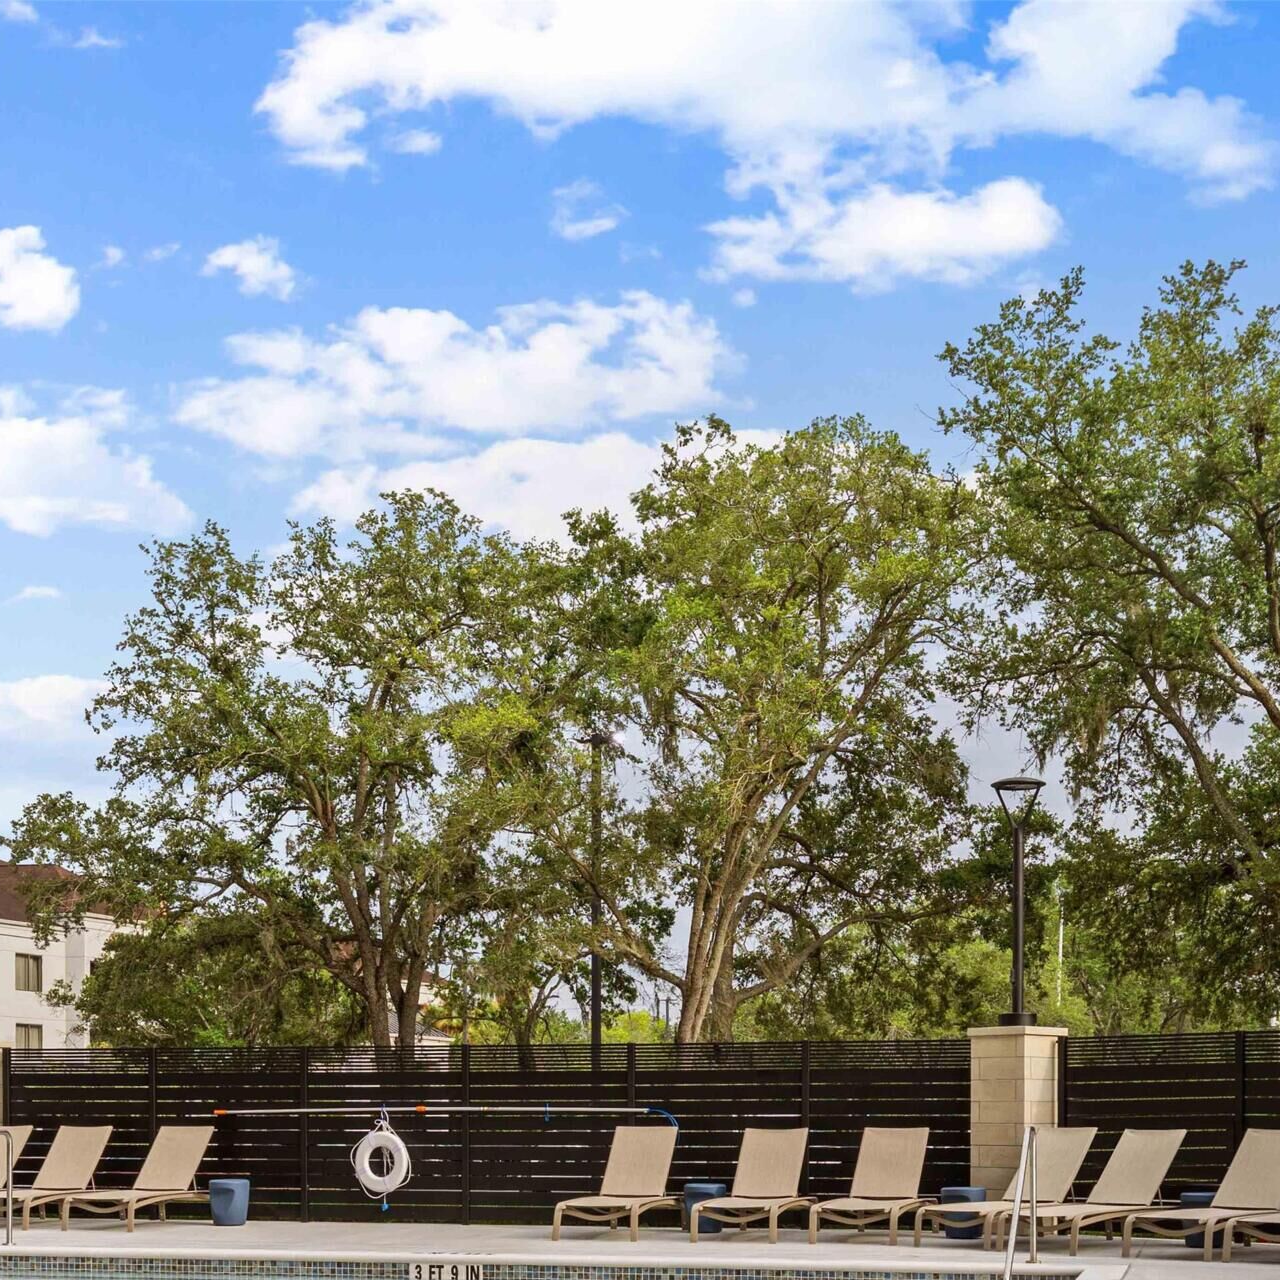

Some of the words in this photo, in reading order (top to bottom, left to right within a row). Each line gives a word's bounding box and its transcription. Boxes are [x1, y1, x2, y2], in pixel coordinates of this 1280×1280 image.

[414, 1264, 422, 1280] 3
[428, 1265, 444, 1280] FT
[451, 1265, 459, 1280] 9
[466, 1265, 480, 1280] IN
